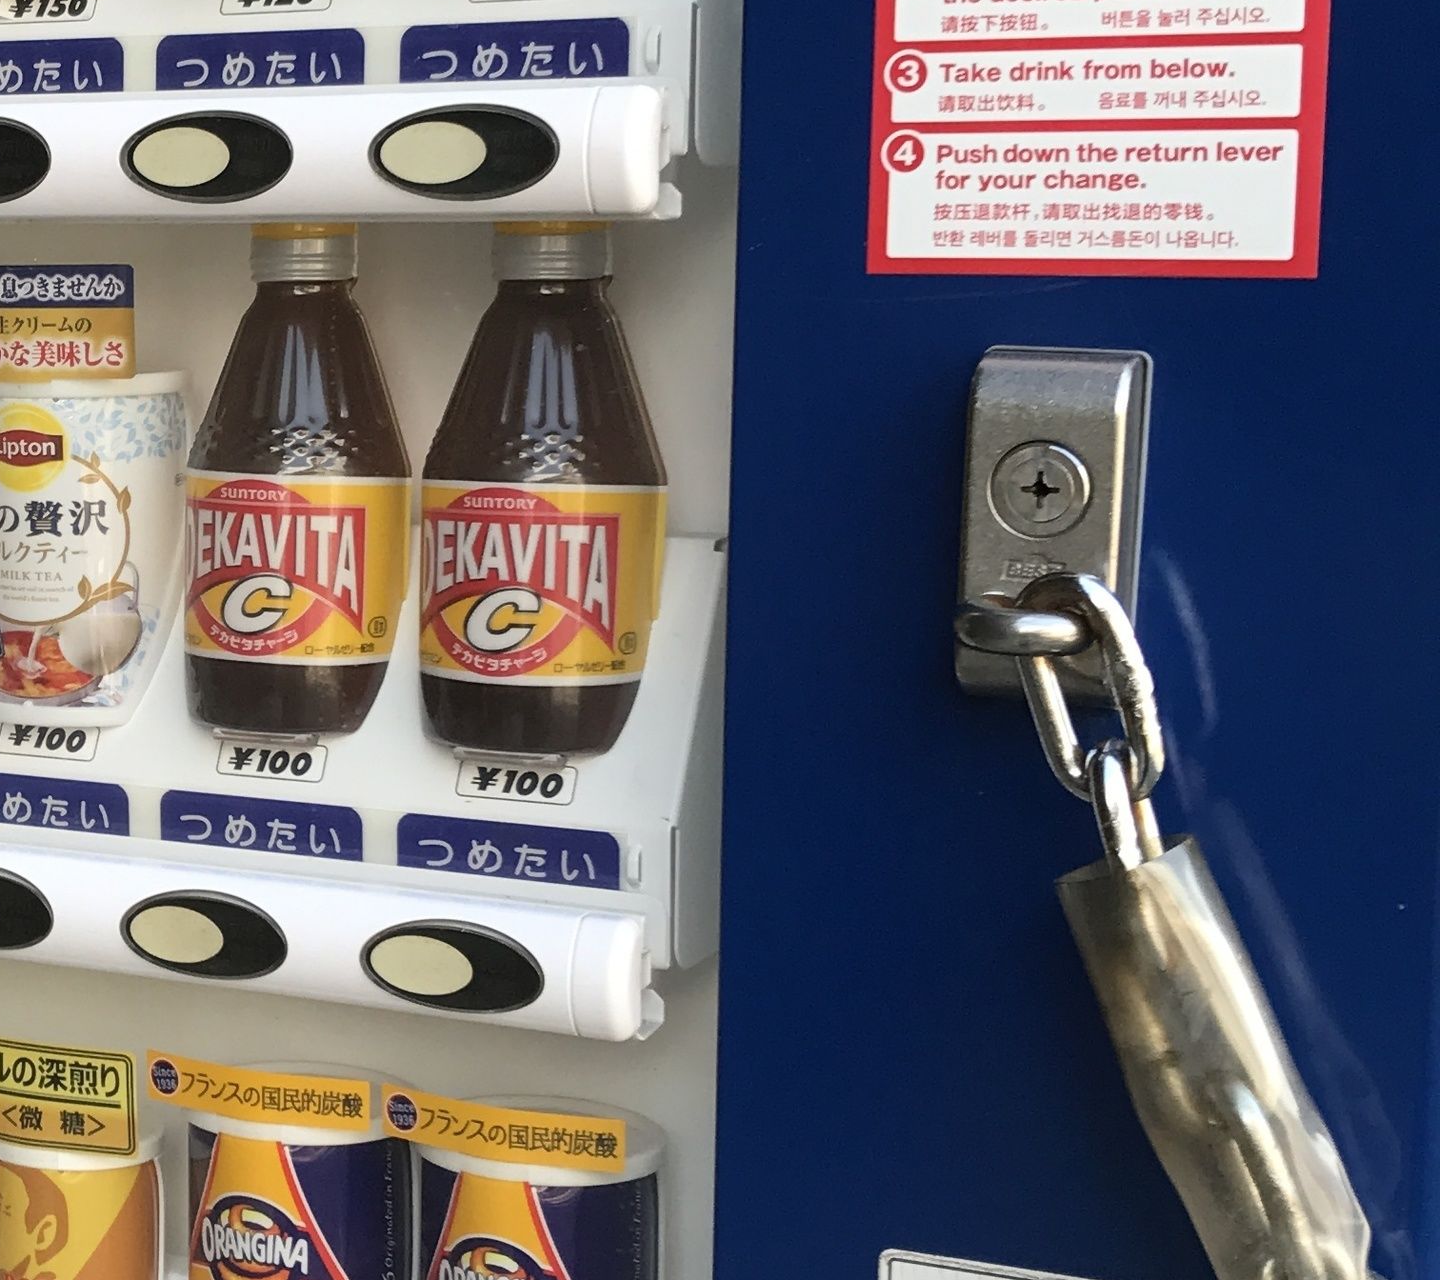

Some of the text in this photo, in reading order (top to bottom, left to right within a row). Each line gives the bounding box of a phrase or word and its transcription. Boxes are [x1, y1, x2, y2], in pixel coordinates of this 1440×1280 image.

[942, 14, 1050, 33] 请按下按钮。
[422, 42, 604, 79] つめたい
[940, 59, 1235, 84] Take drink from below.
[896, 61, 919, 87] 3
[938, 94, 1045, 113] 请取出饮料。
[894, 141, 917, 166] 4
[936, 142, 1283, 164] Push down the return lever
[936, 170, 1146, 191] for your change.
[229, 749, 313, 777] ¥100
[418, 837, 596, 881] つめたい
[182, 1071, 363, 1118] フランスの国民的炭酸
[202, 1217, 307, 1273] ORANGINA
